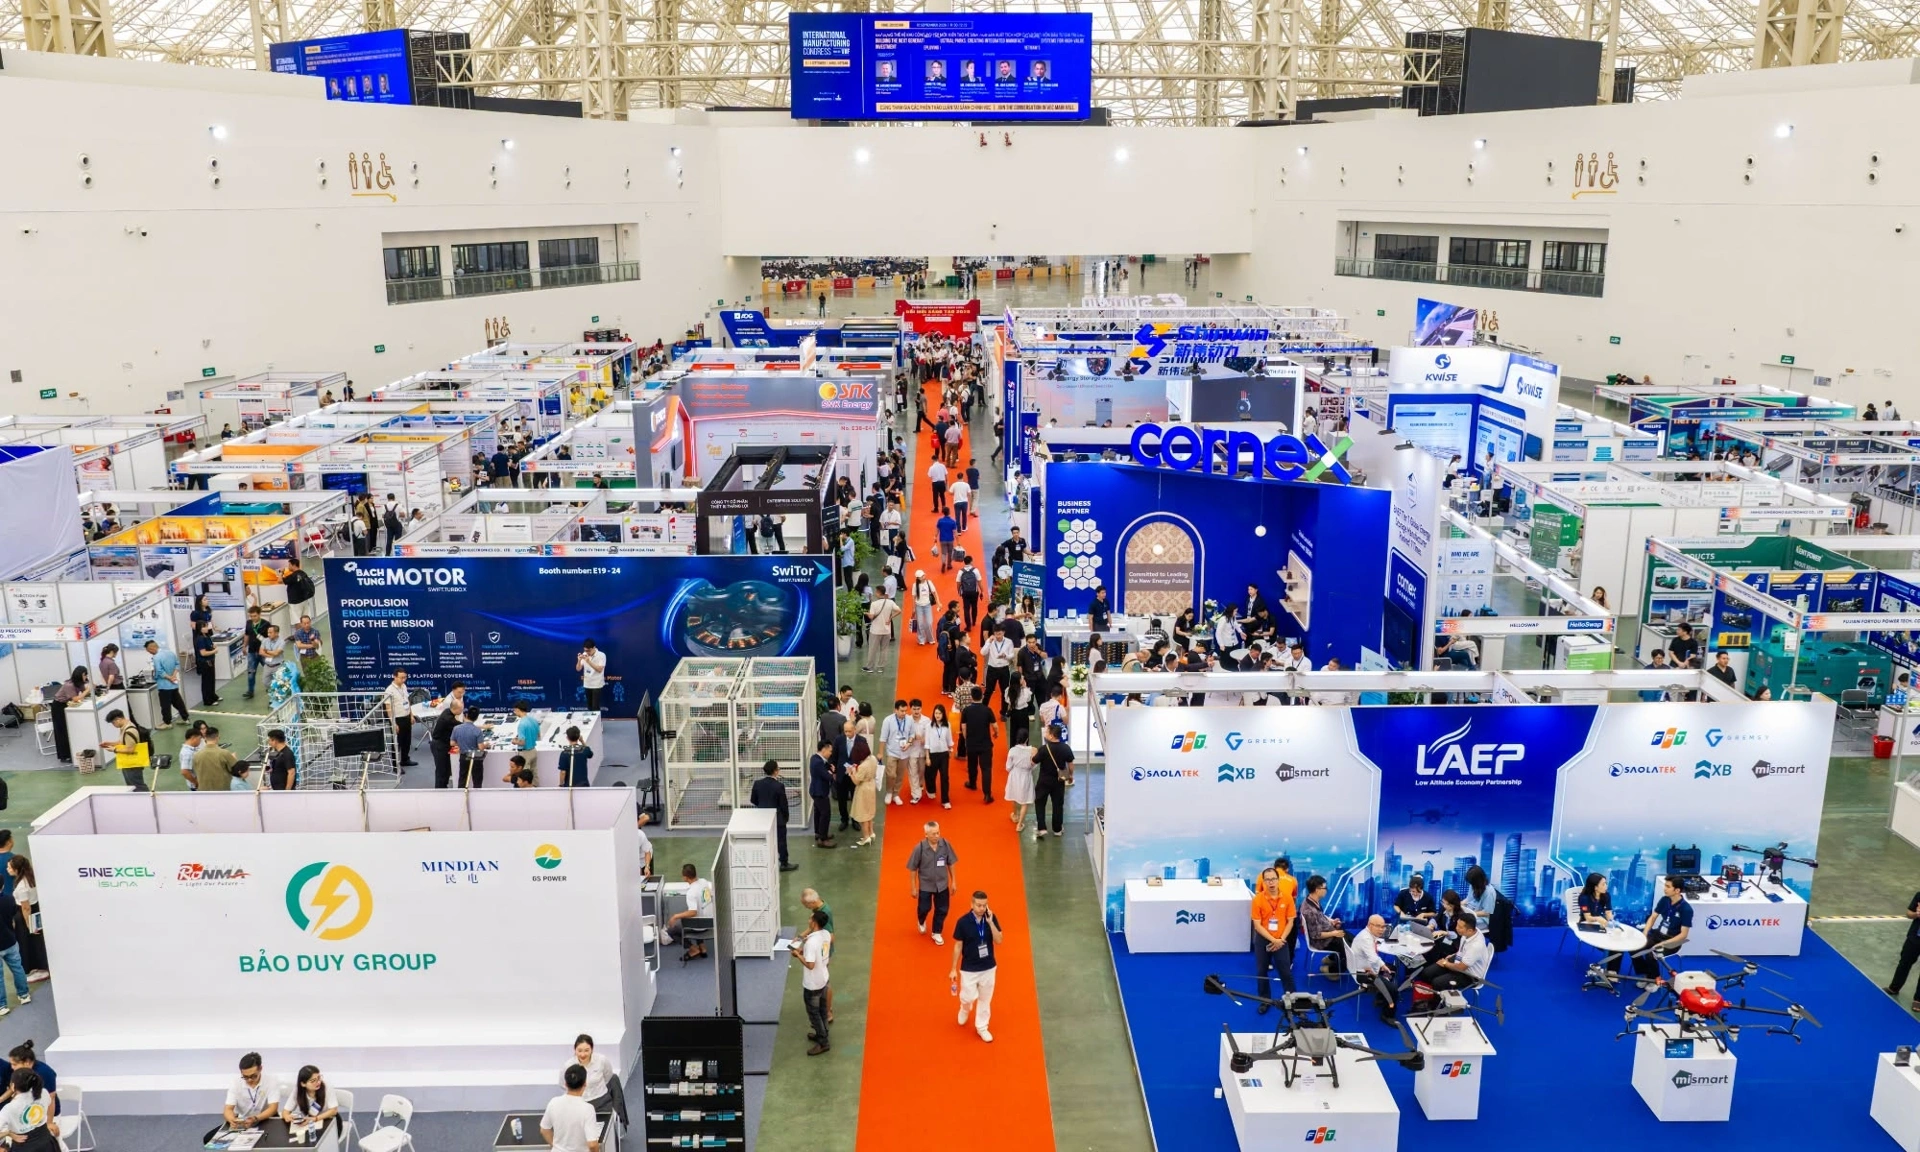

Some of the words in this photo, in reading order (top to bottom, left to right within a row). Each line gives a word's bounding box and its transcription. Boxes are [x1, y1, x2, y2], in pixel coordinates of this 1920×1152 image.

[803, 31, 846, 39] INTERNATIONAL
[803, 39, 850, 48] MANUFACTURING
[803, 48, 832, 56] CONGRESS
[1178, 326, 1269, 341] Shinwin
[842, 400, 873, 410] Energy
[1130, 423, 1354, 486] cornex
[356, 569, 384, 577] BACH
[772, 565, 814, 576] SwiTor
[357, 577, 385, 586] TUNG
[386, 568, 468, 586] MOTOR
[341, 599, 409, 607] PROPULSION
[342, 609, 410, 618] ENGINEERED
[343, 620, 366, 628] FOR
[368, 620, 389, 628] THE
[391, 620, 434, 628] MISSION
[1569, 621, 1602, 629] HelloSwap
[1171, 731, 1208, 752] FPT
[1651, 728, 1688, 749] FPT
[1416, 743, 1526, 775] LAEP
[1235, 768, 1256, 779] XB
[1279, 767, 1330, 779] mismart
[1712, 764, 1732, 776] XB
[1755, 764, 1806, 776] mismart
[1486, 779, 1523, 787] Partnership
[422, 860, 499, 871] MINDIAN
[79, 867, 155, 877] SINEXCEL
[1190, 913, 1206, 922] XB
[1723, 918, 1781, 926] SAOLATEK
[239, 949, 284, 972] BẢO
[297, 954, 344, 971] DUY
[353, 954, 437, 971] GROUP
[1447, 1061, 1472, 1077] FPT
[1675, 1073, 1729, 1086] mismart
[1305, 1127, 1337, 1144] FPT
